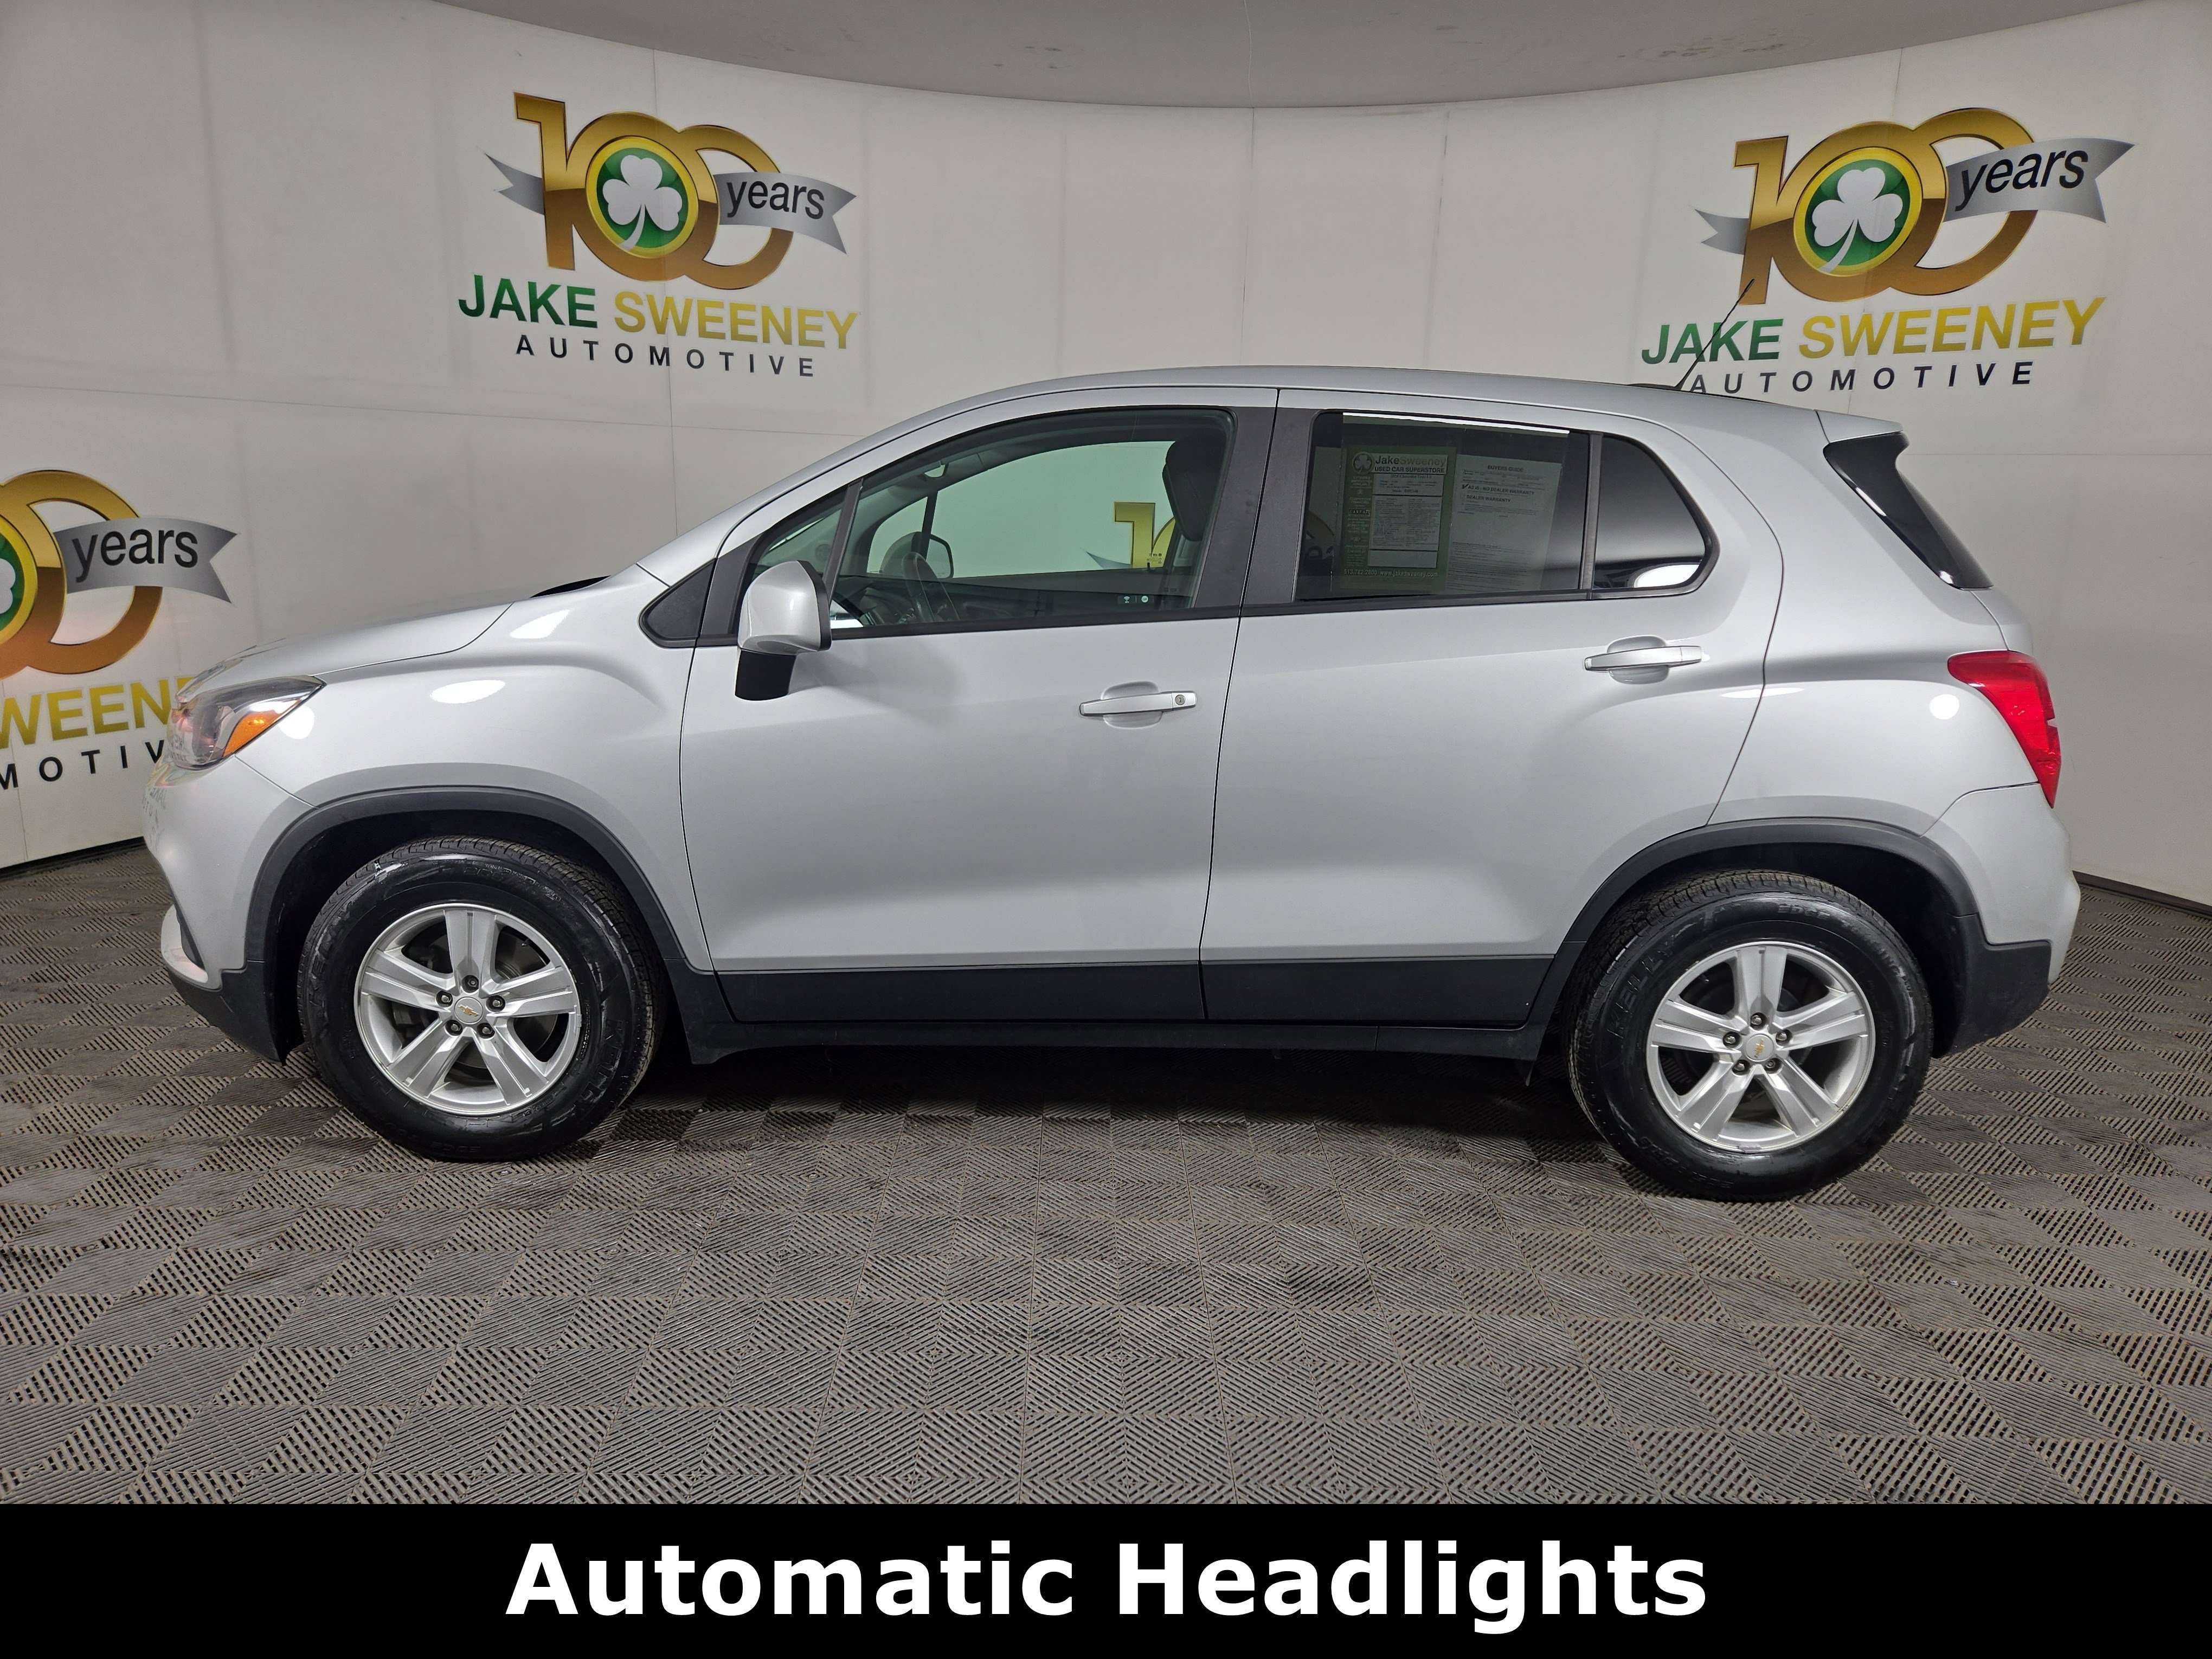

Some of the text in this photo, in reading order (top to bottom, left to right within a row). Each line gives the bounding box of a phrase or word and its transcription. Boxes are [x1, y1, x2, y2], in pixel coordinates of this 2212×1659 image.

[513, 92, 793, 290] 100
[725, 177, 825, 220] years
[1734, 107, 2038, 305] 100
[1953, 147, 2089, 212] years
[458, 274, 859, 350] JAKE SWEENEY
[1641, 297, 2106, 365] JAKE SWEENEY
[515, 334, 814, 377] AUTOMOTIVE
[1689, 361, 2033, 395] AUTOMOTIVE
[71, 528, 199, 583] years
